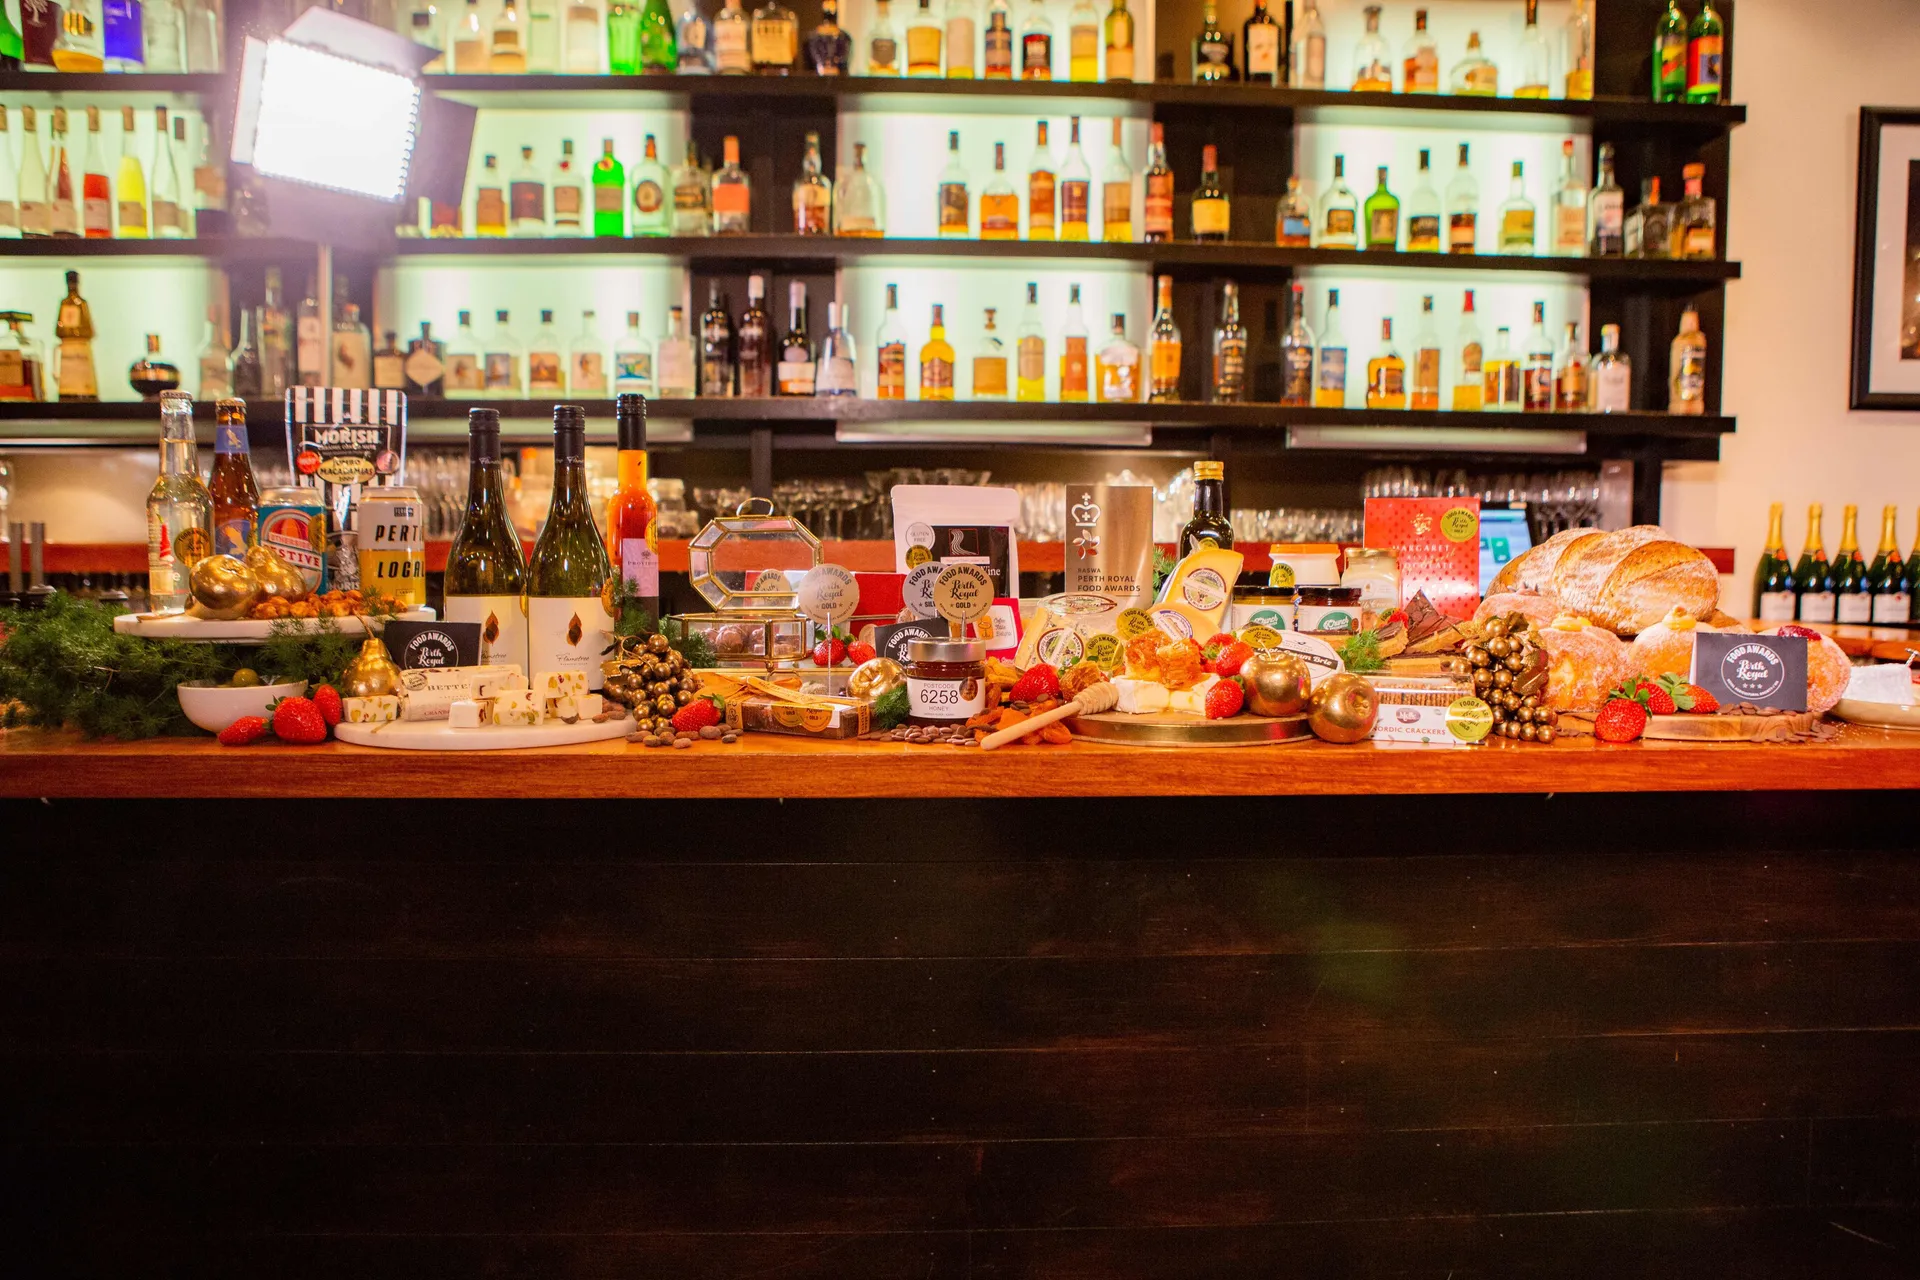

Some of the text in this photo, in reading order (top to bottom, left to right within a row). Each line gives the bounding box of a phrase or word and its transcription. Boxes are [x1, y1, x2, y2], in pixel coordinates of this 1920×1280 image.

[315, 428, 379, 444] MORISH
[320, 467, 374, 475] MACADAMIAS
[1457, 510, 1475, 522] AWARDS
[377, 561, 425, 578] LOCAL
[759, 571, 782, 586] AWARDS
[820, 567, 853, 586] AWARDS
[908, 568, 927, 587] FOOD
[938, 566, 988, 587] FOOD AWARDS
[1077, 575, 1135, 583] PERTH ROYAL
[950, 579, 976, 591] Perth
[1077, 584, 1141, 592] FOOD AWARDS
[815, 588, 845, 601] Royal
[949, 587, 979, 601] Royal
[1136, 610, 1153, 627] AWARDS
[409, 632, 455, 652] FOOD AWARDS
[887, 628, 929, 649] FOOD AWARD
[1087, 638, 1099, 650] FOOD
[419, 646, 443, 657] Perth
[1725, 645, 1780, 666] FOOD AWARDS
[417, 655, 445, 667] Royal
[1312, 655, 1333, 666] Brie
[1738, 659, 1766, 671] Perth
[1736, 667, 1769, 681] Royal
[427, 684, 471, 692] BETTE
[919, 689, 959, 704] 6258
[1459, 700, 1475, 708] FOOD
[1405, 727, 1446, 736] CRACKERS
